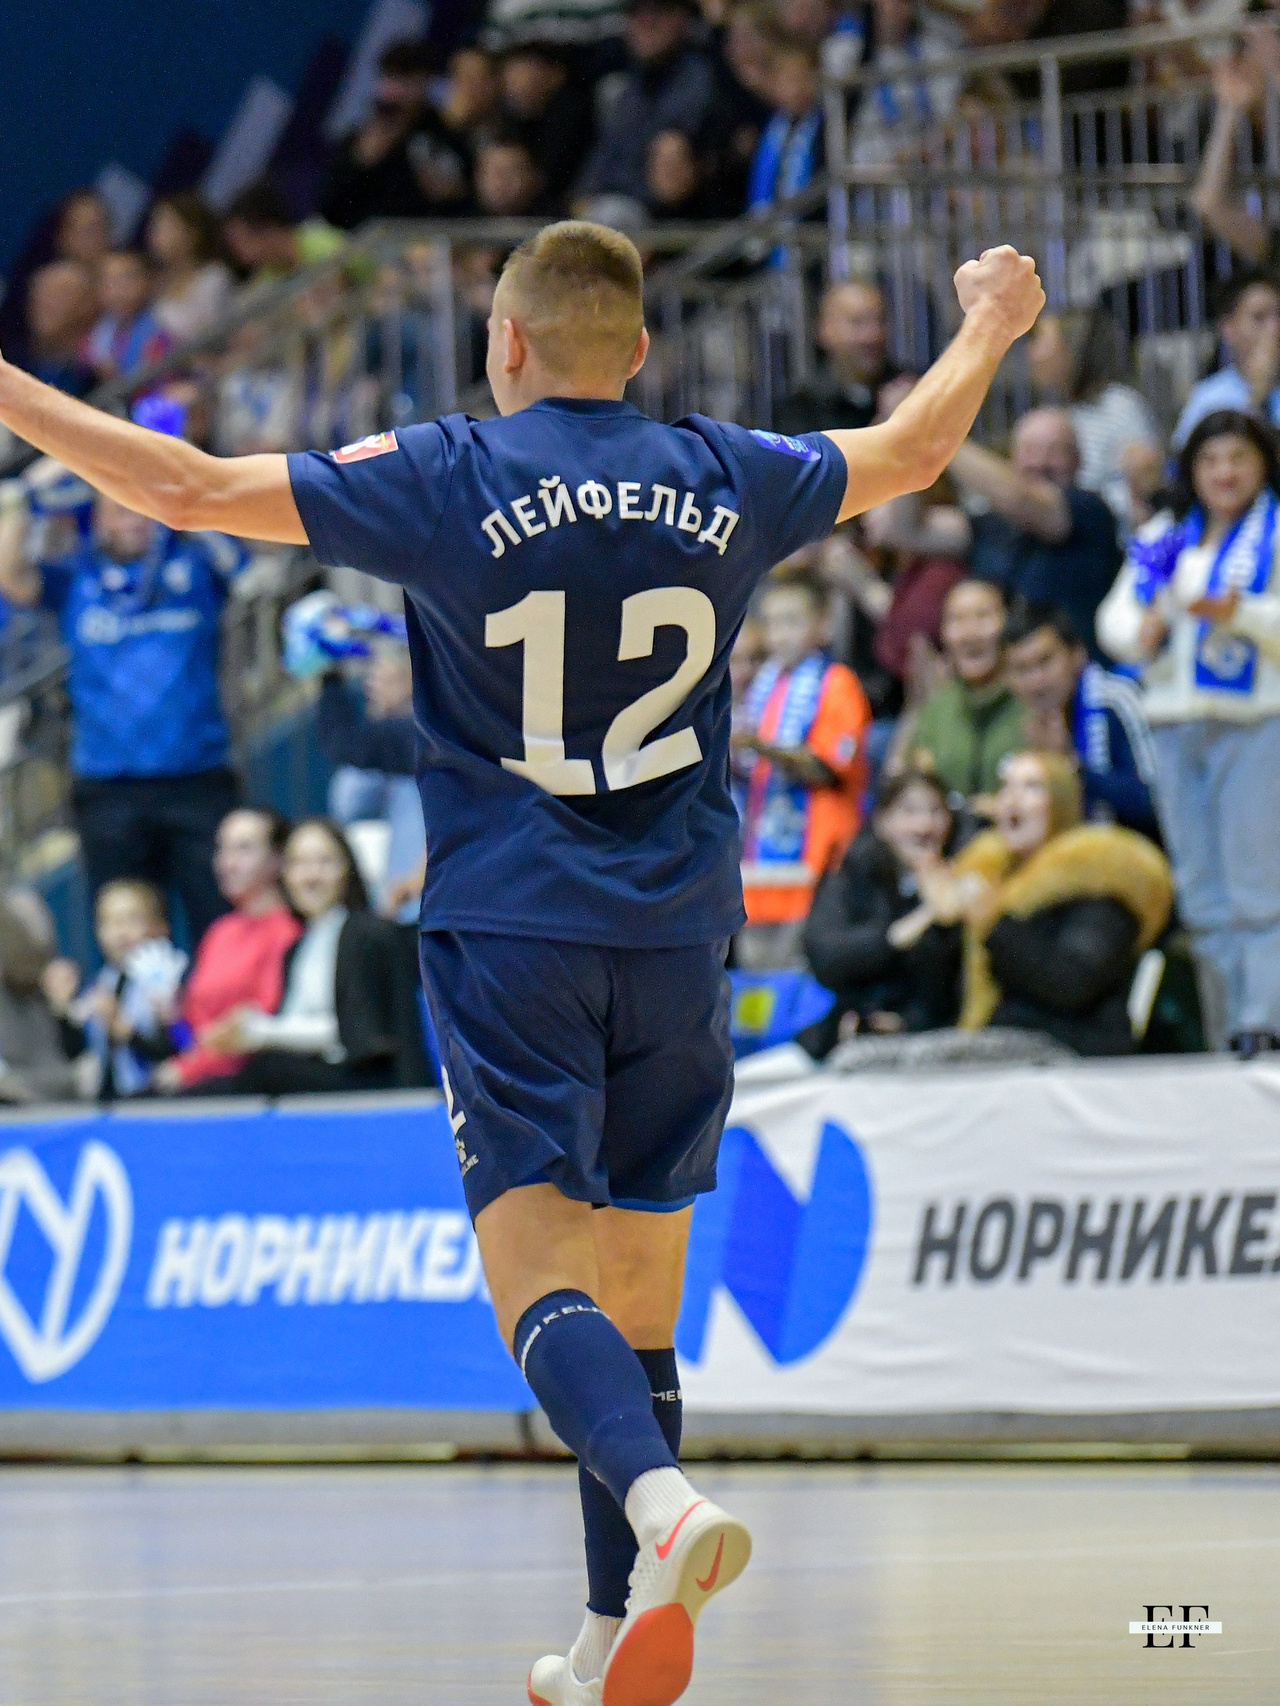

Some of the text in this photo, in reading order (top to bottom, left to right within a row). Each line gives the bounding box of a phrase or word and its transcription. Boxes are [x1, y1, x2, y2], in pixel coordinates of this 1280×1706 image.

[480, 475, 740, 559] ЛЕЙФЕЛЬД
[485, 586, 717, 796] 12
[912, 1193, 1280, 1283] НОРНИКЕ
